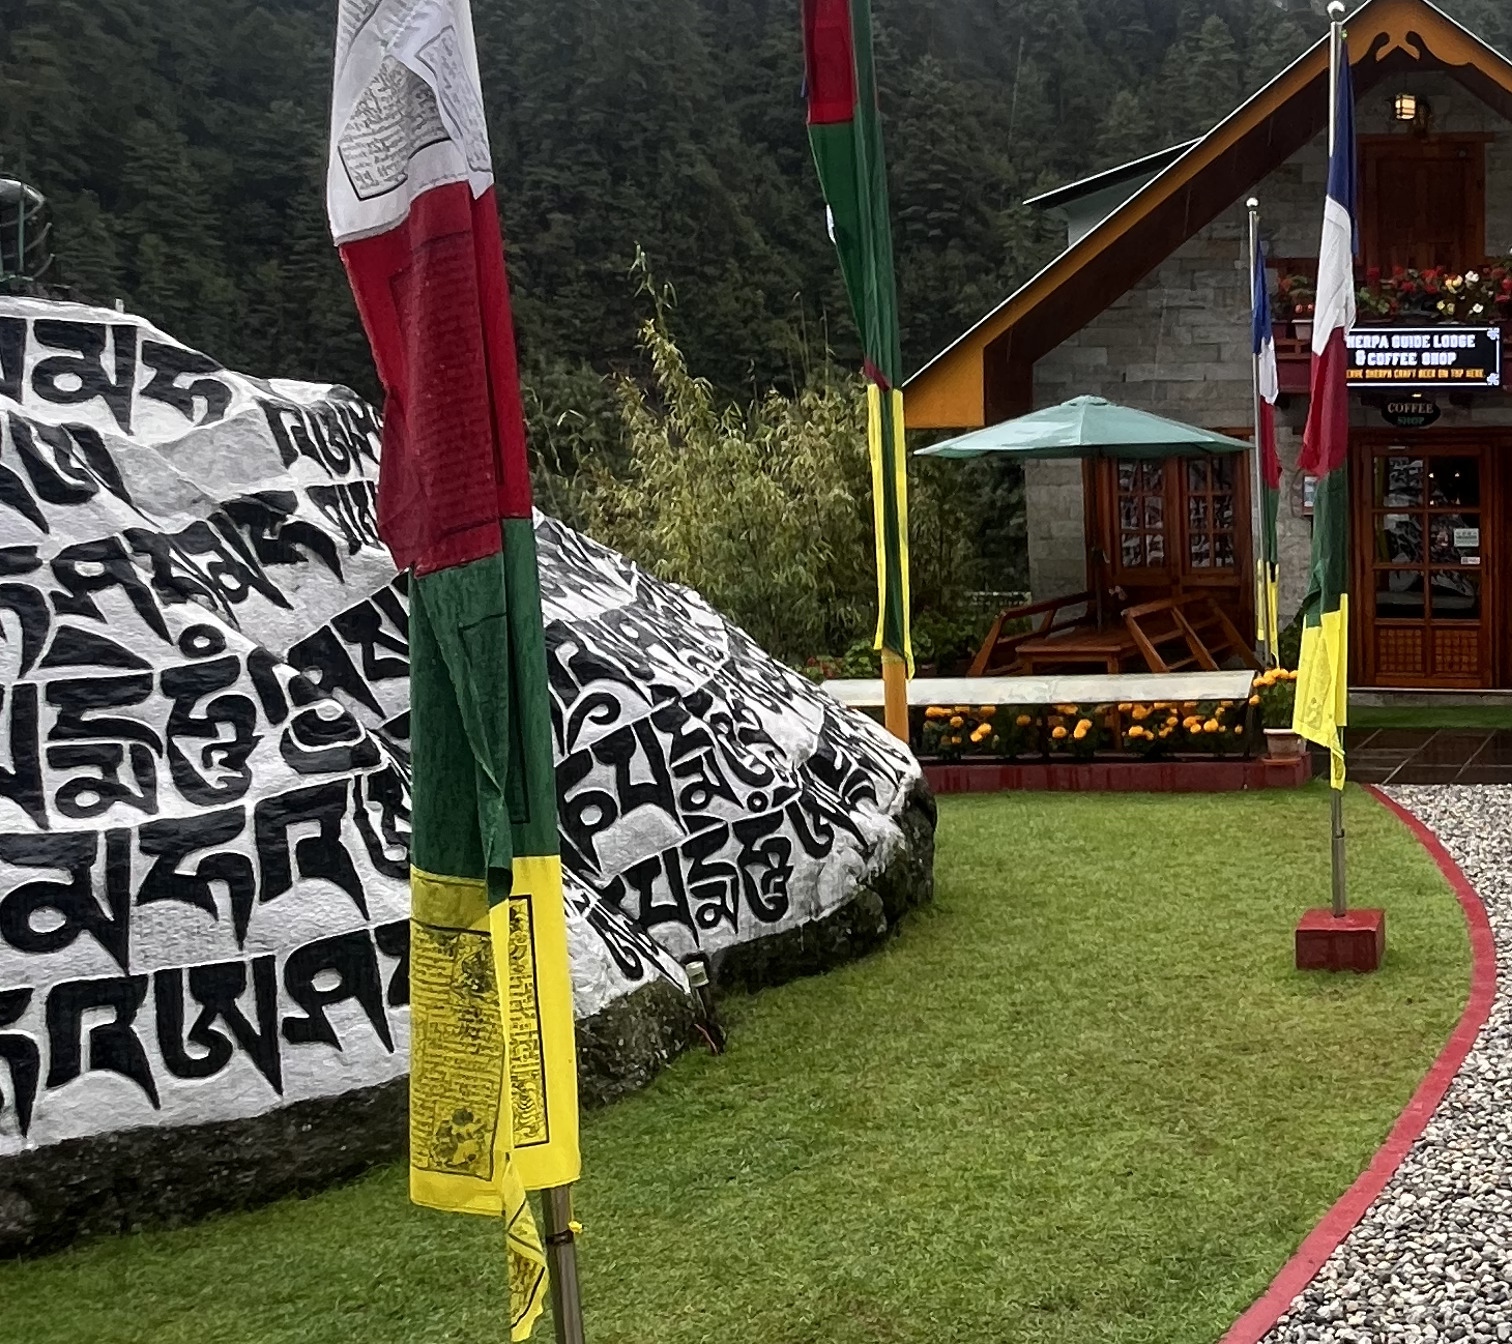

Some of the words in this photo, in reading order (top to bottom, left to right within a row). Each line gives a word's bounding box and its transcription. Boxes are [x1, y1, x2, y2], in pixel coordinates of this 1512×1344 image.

[1391, 335, 1430, 348] GUIDE
[1433, 334, 1475, 348] LODGE
[1367, 352, 1418, 366] COFFEE
[1421, 352, 1457, 366] SHOP
[1387, 402, 1434, 414] COFFEE
[1397, 416, 1425, 425] SHOP
